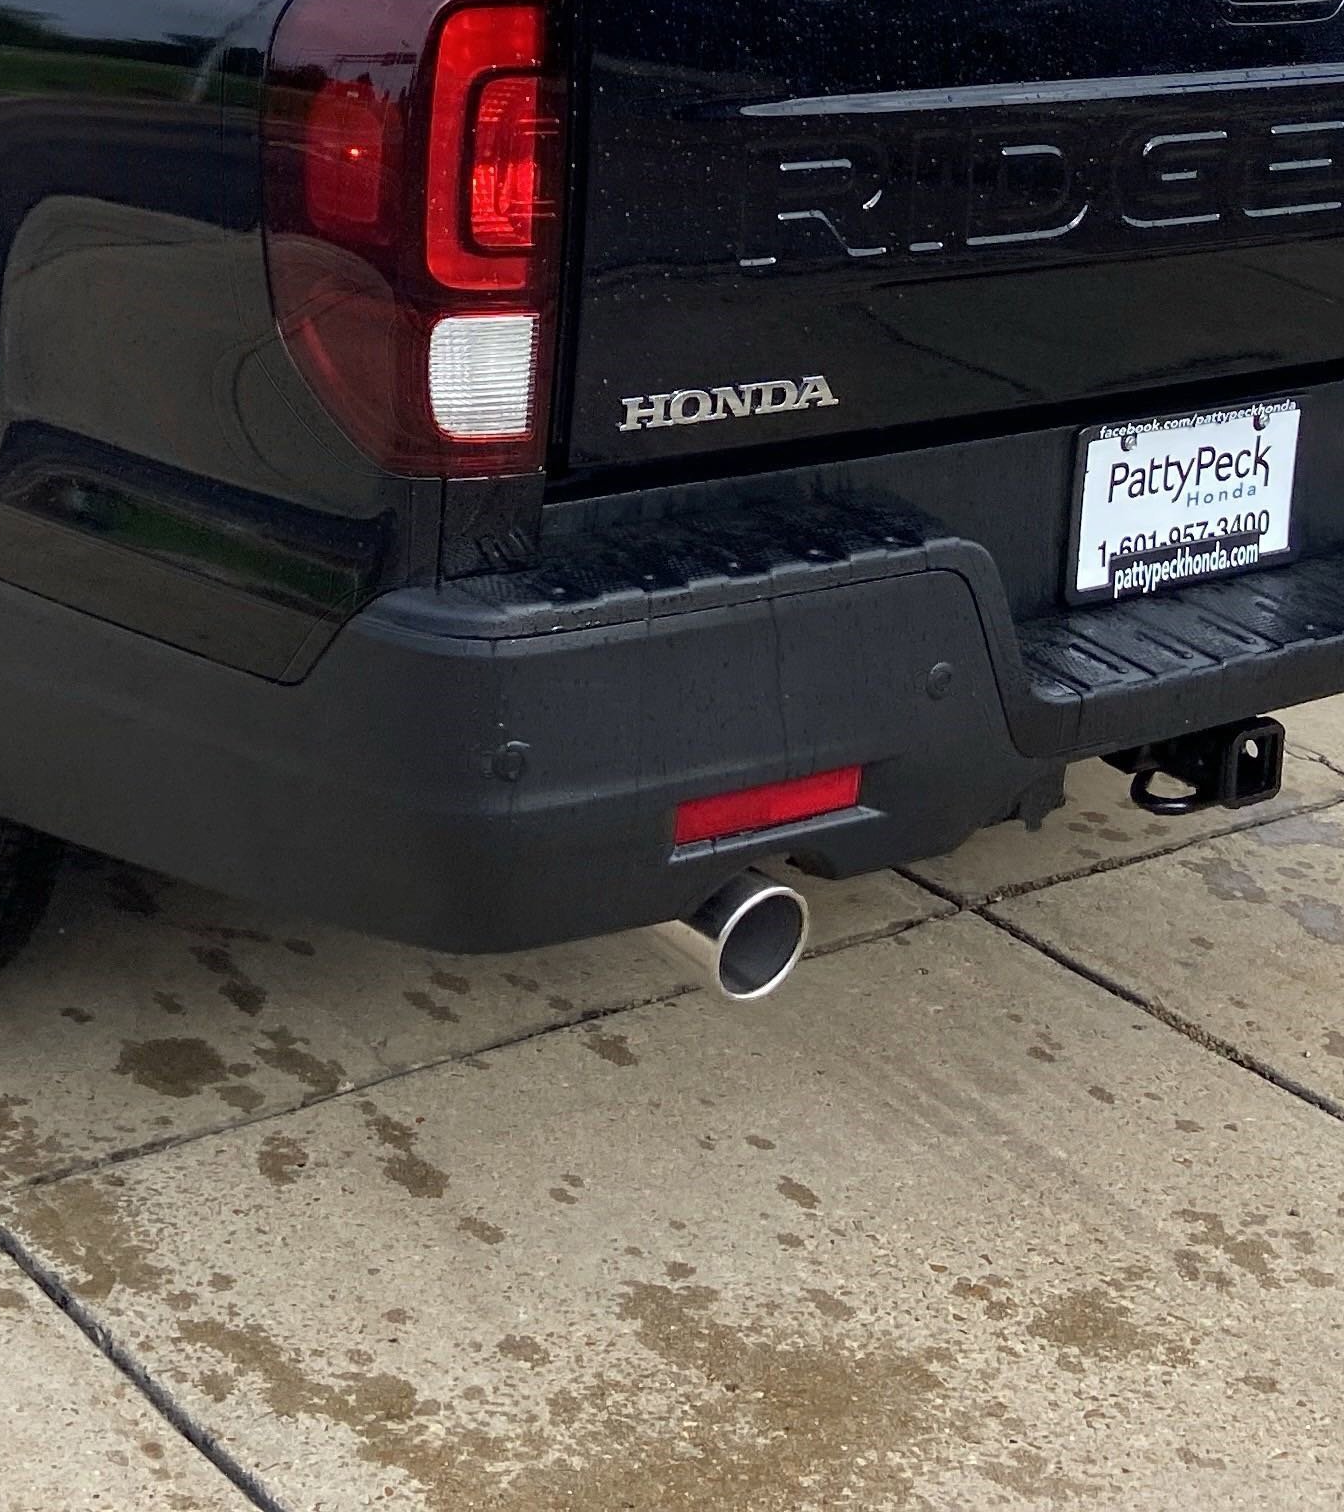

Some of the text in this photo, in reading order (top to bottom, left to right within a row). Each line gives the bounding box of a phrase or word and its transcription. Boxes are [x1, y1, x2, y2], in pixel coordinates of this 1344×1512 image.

[617, 375, 840, 432] HONDA
[1108, 435, 1272, 503] PattyPeck
[1186, 482, 1257, 507] Honda
[1113, 541, 1260, 598] pattypeckhonda.com
